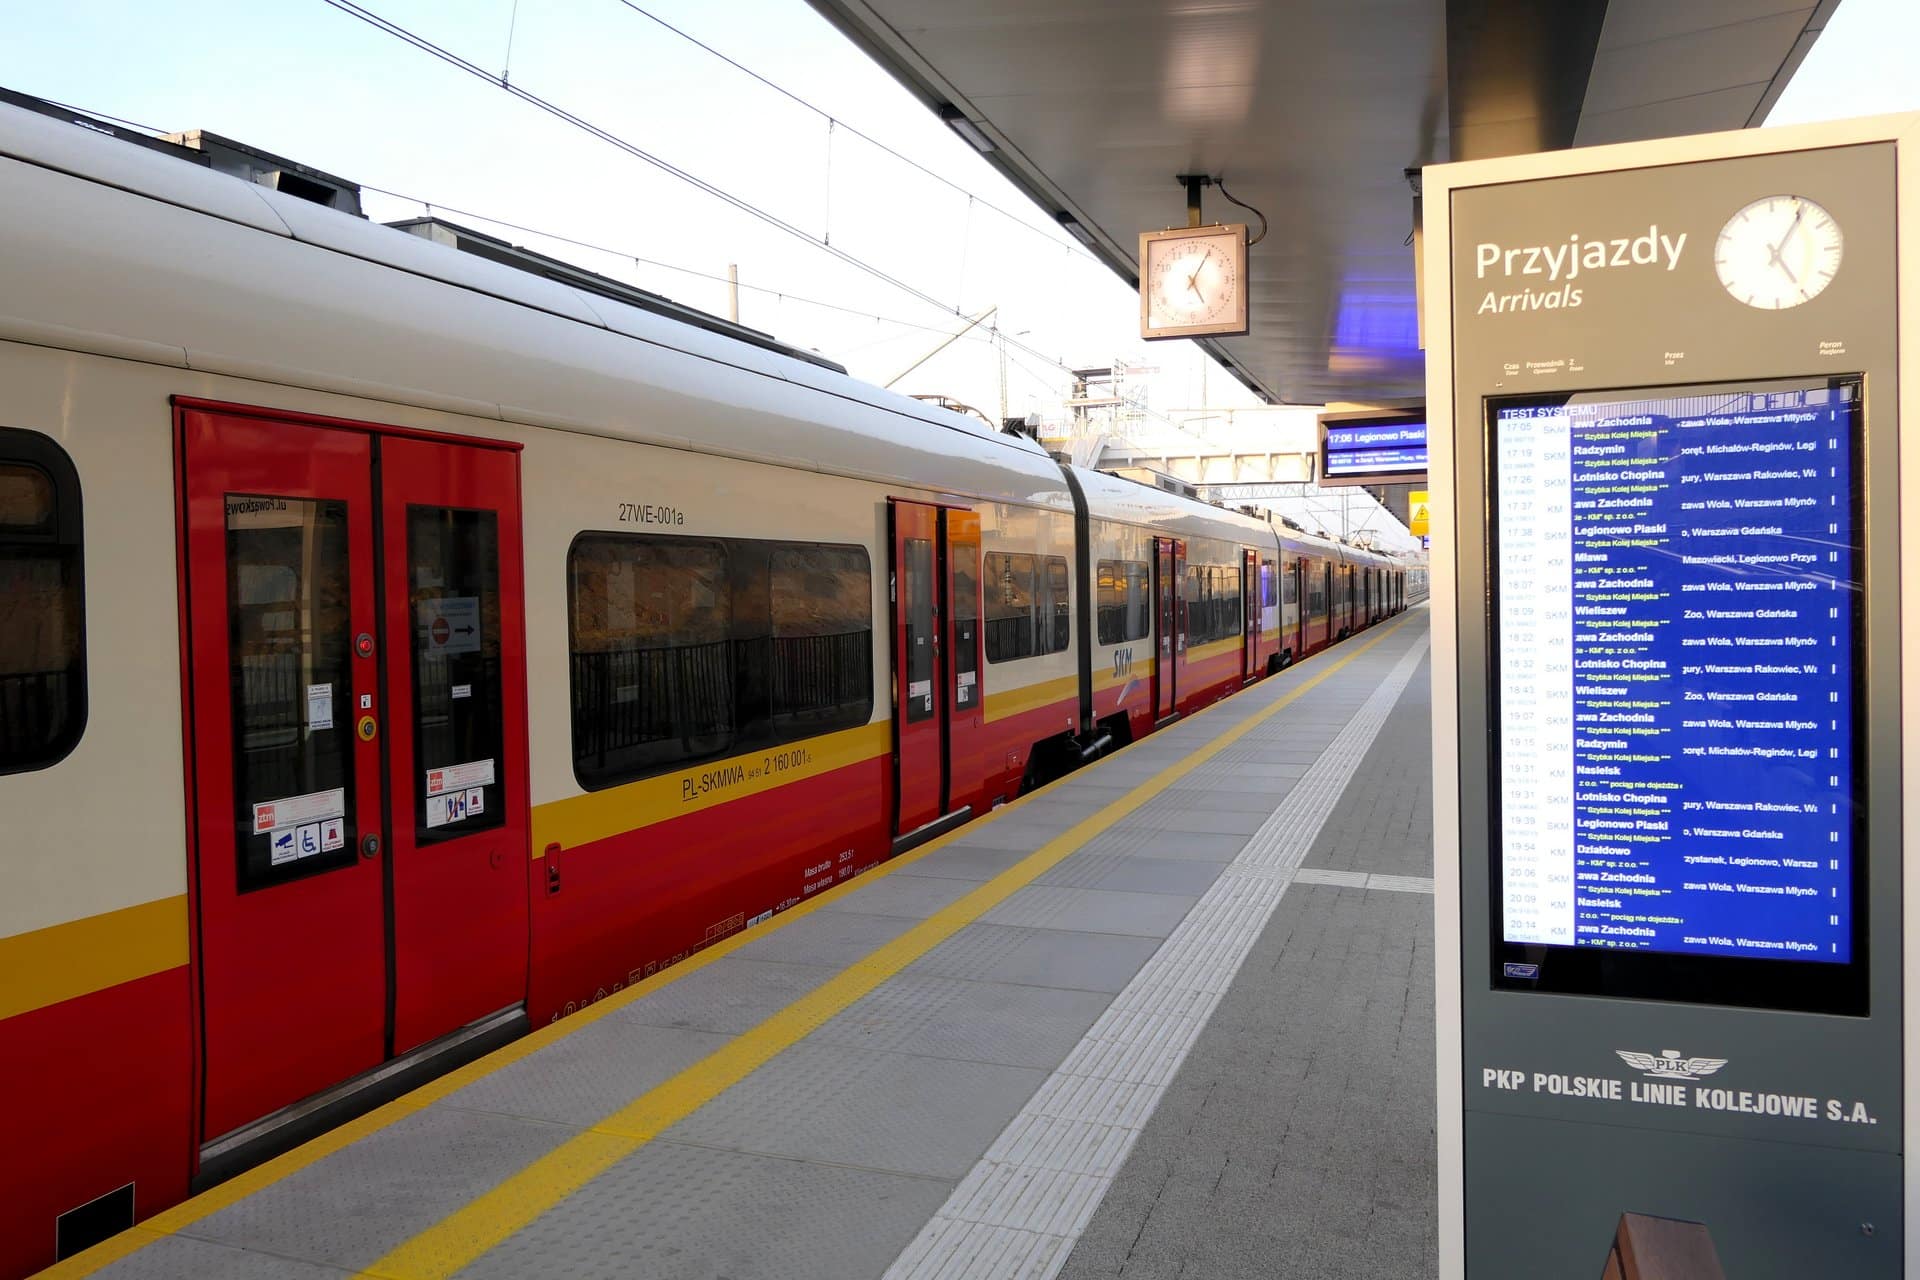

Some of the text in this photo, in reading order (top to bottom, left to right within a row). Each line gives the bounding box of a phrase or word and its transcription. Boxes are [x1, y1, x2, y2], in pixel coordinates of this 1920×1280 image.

[1477, 225, 1687, 281] Przyjazdy
[1477, 283, 1583, 315] Arrivals
[1819, 341, 1842, 349] Peron
[1664, 351, 1684, 359] Przez
[1502, 405, 1597, 419] TEST SYSTEMU
[1597, 416, 1652, 426] Zachodnia
[1681, 419, 1705, 427] zawa
[1706, 416, 1732, 427] Wola,
[1734, 415, 1782, 425] Warszawa
[1355, 433, 1398, 444] Legionowo
[1574, 444, 1625, 456] Radzymin
[1706, 442, 1794, 453] Michałów-Reginów,
[1573, 470, 1664, 482] Lotnisko Chopina
[1704, 473, 1752, 481] Warszawa
[1753, 470, 1800, 479] Rakowiec,
[1598, 497, 1653, 508] Zachodnia
[1706, 500, 1732, 508] Wola,
[1734, 499, 1783, 508] Warszawa
[619, 503, 684, 525] 27WE-001a
[1574, 524, 1666, 537] Legionowo Piaski
[1692, 528, 1739, 536] Warszawa
[1740, 526, 1782, 537] Gdańska
[1574, 553, 1608, 562] Mława
[1682, 553, 1817, 565] Mazowiecki, Legionowo Przys
[1598, 578, 1654, 588] Zachodnia
[1707, 582, 1733, 591] Wola,
[1735, 582, 1783, 590] Warszawa
[1574, 606, 1627, 615] Wieliszew
[1684, 610, 1797, 619] Zoo, Warszawa Gdańska
[1613, 620, 1631, 628] Kolej
[1632, 619, 1660, 628] Miejska
[1598, 632, 1654, 642] Zachodnia
[1707, 637, 1733, 646] Wola,
[1735, 637, 1784, 645] Warszawa
[1110, 647, 1125, 668] SKM
[1575, 659, 1666, 670] Lotnisko Chopina
[1705, 665, 1801, 674] Warszawa Rakowiec,
[1576, 686, 1628, 695] Wieliszew
[1684, 692, 1798, 701] Zoo, Warszawa Gdańska
[1599, 713, 1654, 722] Zachodnia
[1708, 720, 1734, 728] Wola,
[1736, 720, 1784, 728] Warszawa
[1576, 739, 1628, 750] Radzymin
[1708, 747, 1796, 758] Michałów-Reginów,
[682, 765, 744, 799] PL-SKMWA
[764, 758, 770, 775] 2
[773, 753, 788, 772] 160
[1576, 766, 1620, 775] Nasielsk
[1576, 792, 1667, 804] Lotnisko Chopina
[1706, 801, 1802, 812] Warszawa Rakowiec,
[258, 812, 274, 823] ztm
[1577, 818, 1668, 830] Legionowo Piaski
[1693, 828, 1741, 837] Warszawa
[1742, 830, 1783, 839] Gdańska
[1577, 844, 1631, 855] Działdowo
[1729, 856, 1780, 867] Legionowo,
[1782, 858, 1818, 868] Warsza
[804, 866, 817, 878] Masa
[817, 860, 832, 872] brutto
[1600, 872, 1655, 883] Zachodnia
[803, 882, 817, 894] Masa
[1708, 882, 1734, 892] Wola,
[1736, 884, 1784, 894] Warszawa
[1578, 897, 1621, 908] Nasielsk
[1601, 925, 1656, 936] Zachodnia
[1708, 937, 1734, 946] Wola,
[1736, 938, 1784, 948] Warszawa
[1655, 1059, 1687, 1072] PLK
[1483, 1068, 1877, 1124] PKP POLSKIE LINIE KOLEJOWE S.A.
